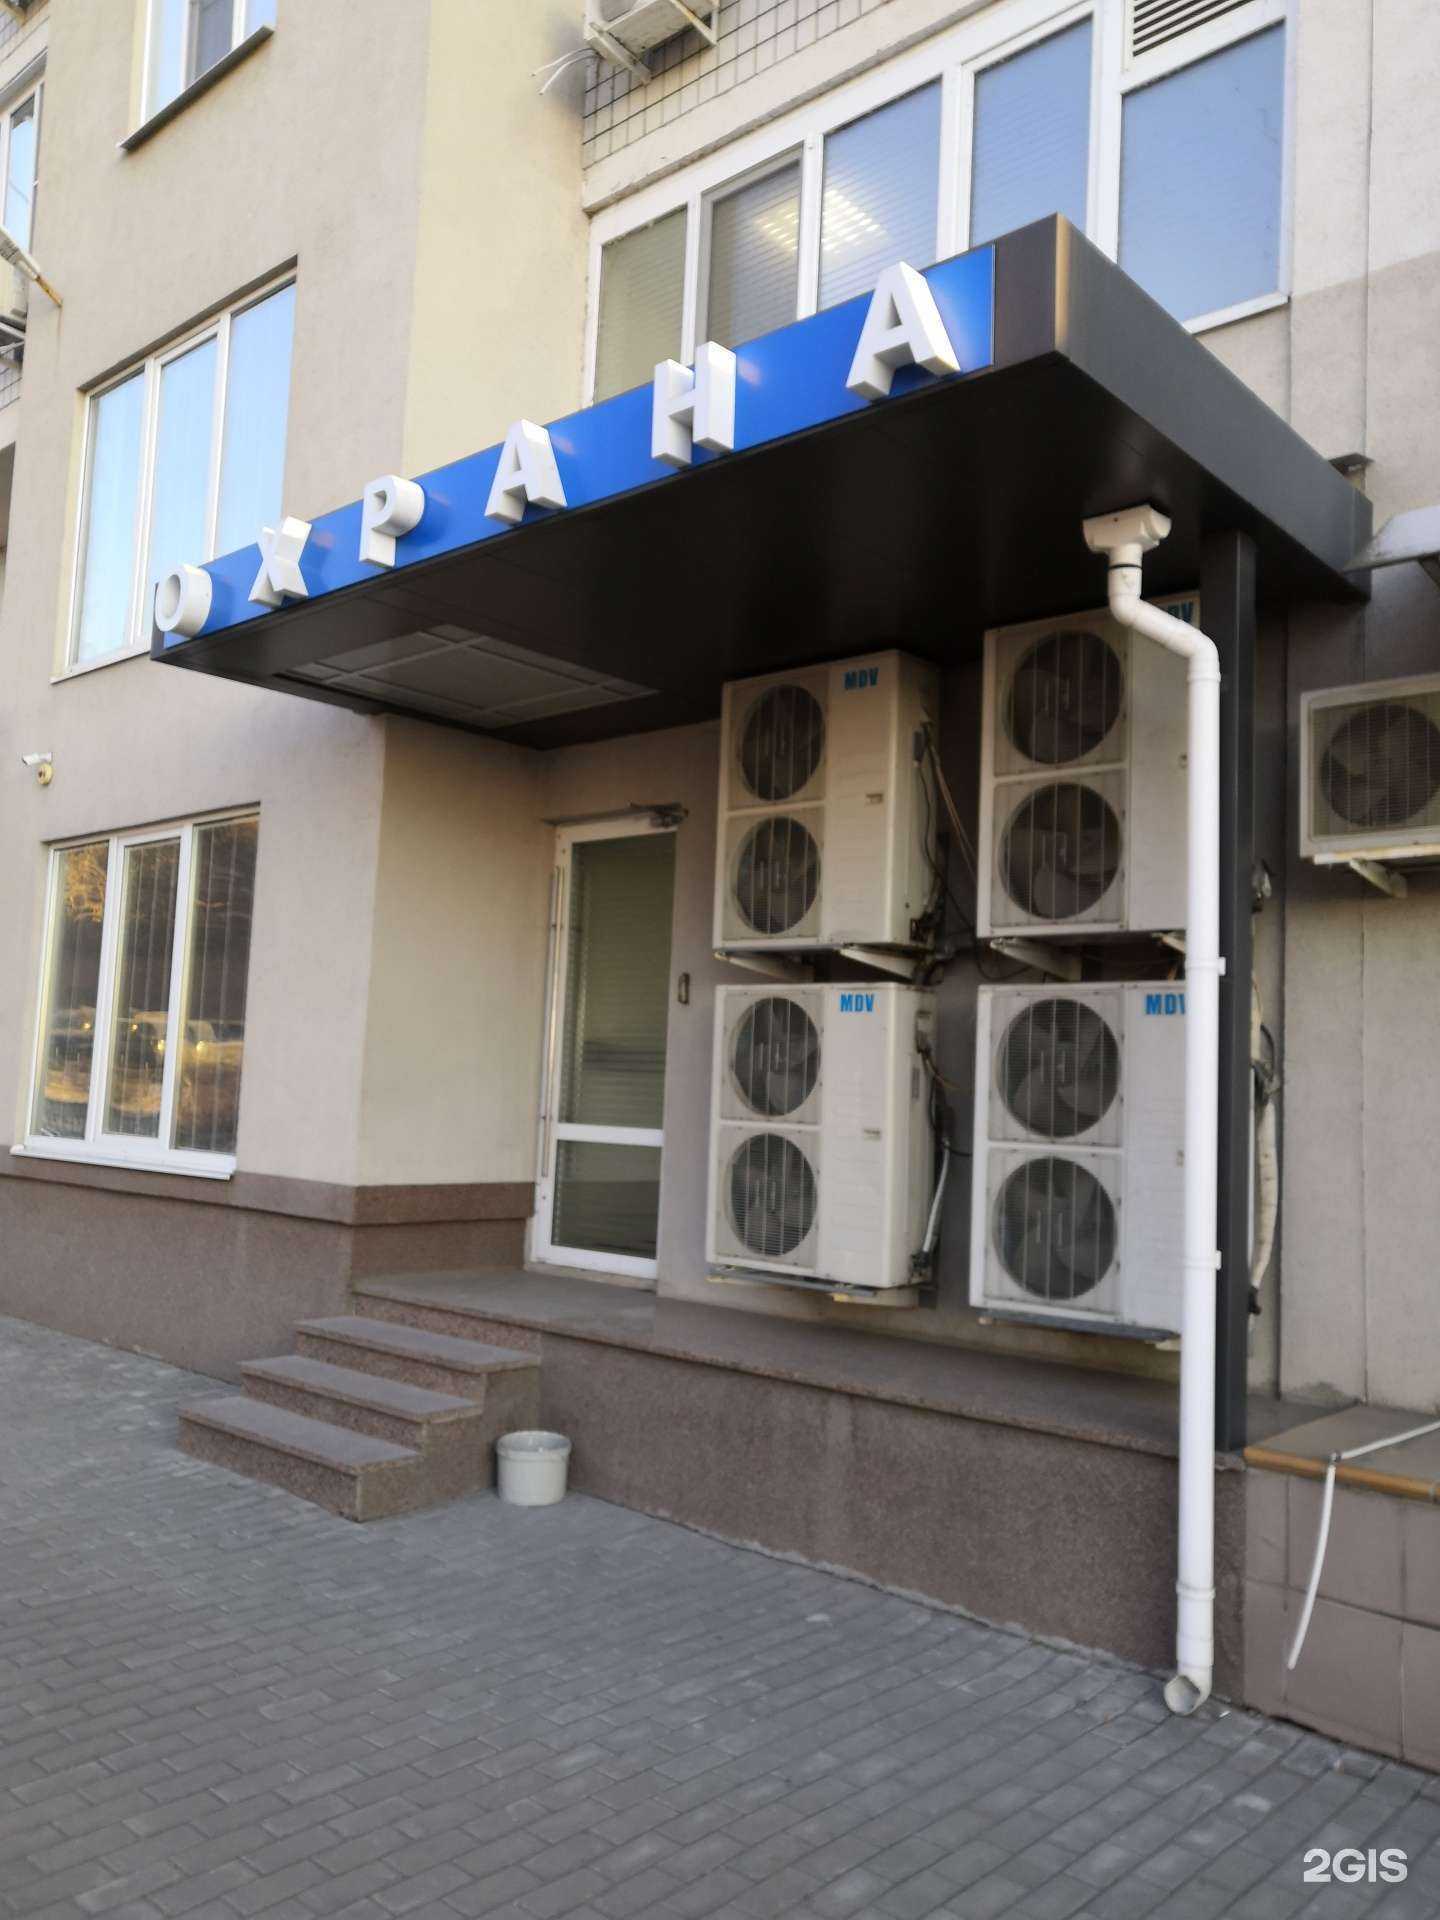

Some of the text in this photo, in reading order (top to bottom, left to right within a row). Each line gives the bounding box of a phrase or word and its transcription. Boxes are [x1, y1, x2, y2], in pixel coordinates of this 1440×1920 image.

[155, 261, 960, 637] ОХРАНА
[844, 667, 879, 689] MDV
[840, 993, 874, 1012] MDV
